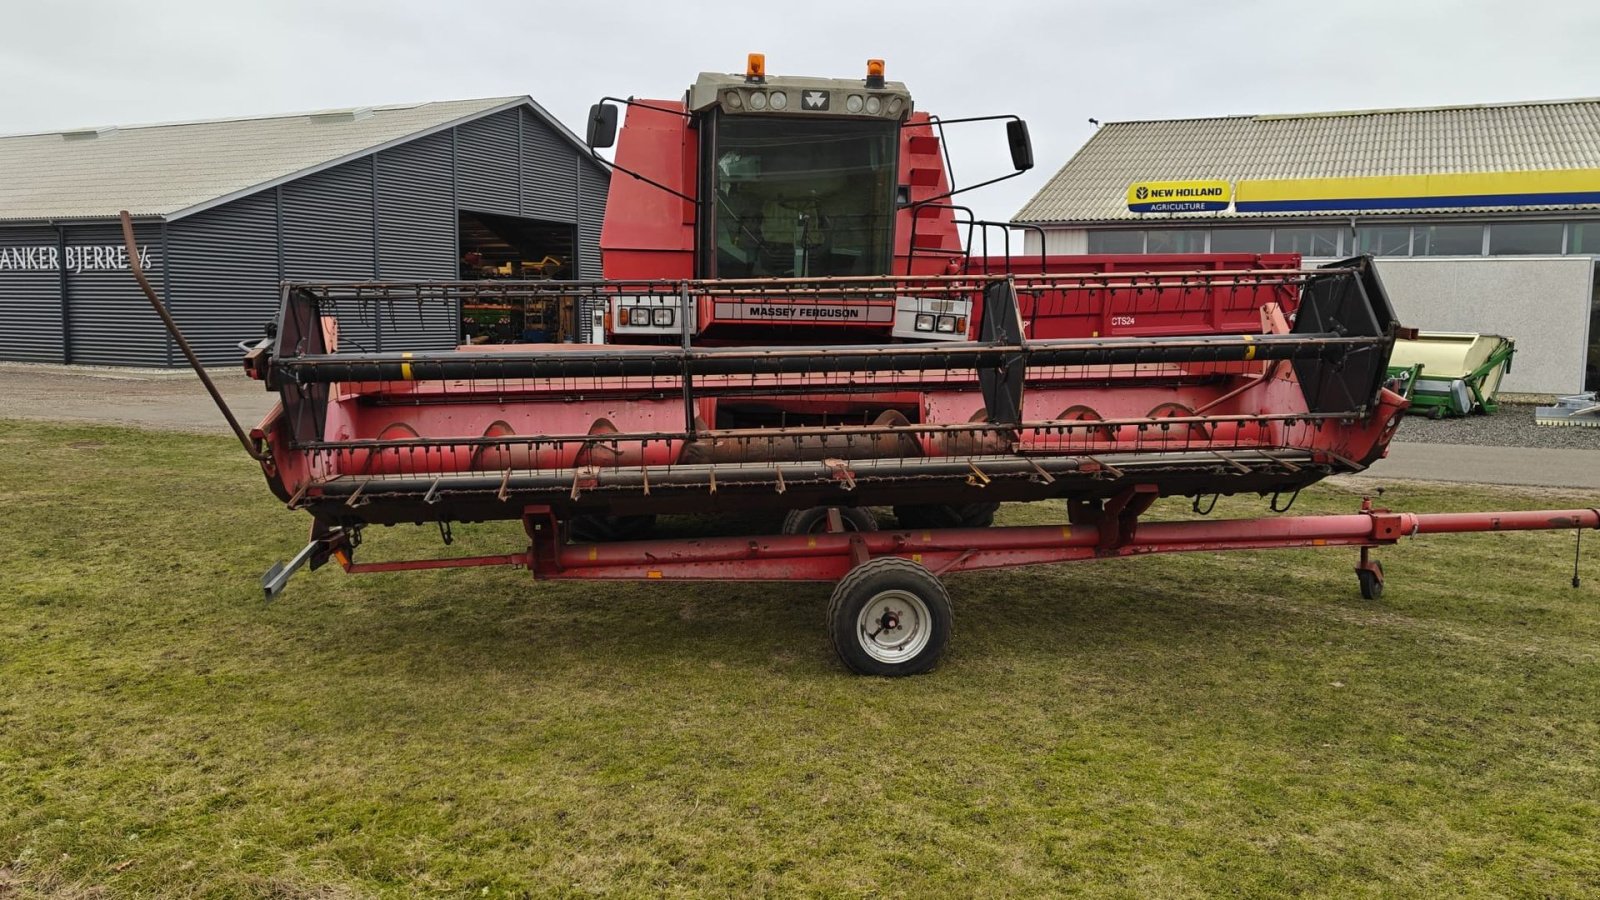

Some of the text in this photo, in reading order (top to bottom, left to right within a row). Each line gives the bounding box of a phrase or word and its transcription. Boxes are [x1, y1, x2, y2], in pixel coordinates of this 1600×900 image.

[1151, 188, 1222, 197] NEW HOLLAND
[1151, 203, 1205, 211] AGRICULTURE
[0, 247, 59, 269] ANKER
[65, 246, 127, 273] BJERRE
[750, 308, 859, 317] MASSEY FERGUSON
[1111, 317, 1135, 325] CTS24
